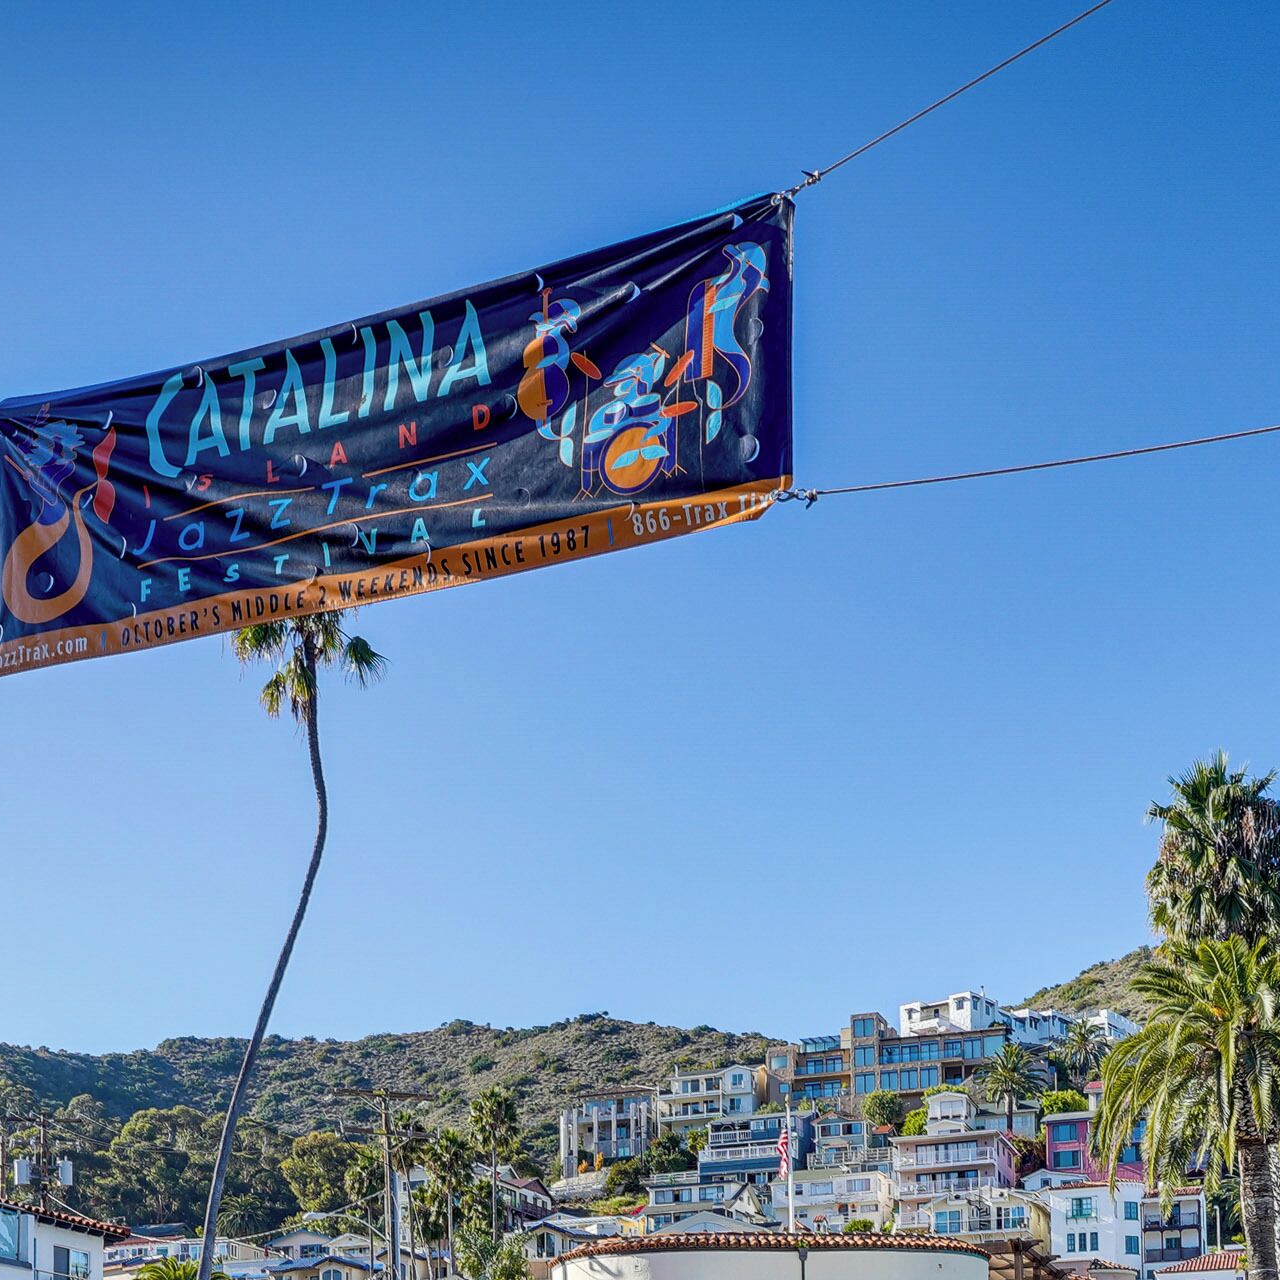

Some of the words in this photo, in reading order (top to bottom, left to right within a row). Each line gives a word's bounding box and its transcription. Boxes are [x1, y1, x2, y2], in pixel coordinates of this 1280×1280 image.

[146, 299, 491, 478] CATALINA
[143, 404, 491, 508] ISLAND
[121, 611, 221, 646] OCTOBER'S
[231, 590, 306, 622] MIDDLE
[319, 586, 327, 605] 2
[338, 558, 452, 600] WEEKENDS
[463, 541, 525, 576] SINCE
[538, 525, 591, 558] 1987
[632, 502, 729, 536] 866-Trax
[140, 508, 486, 602] FESTIVAL
